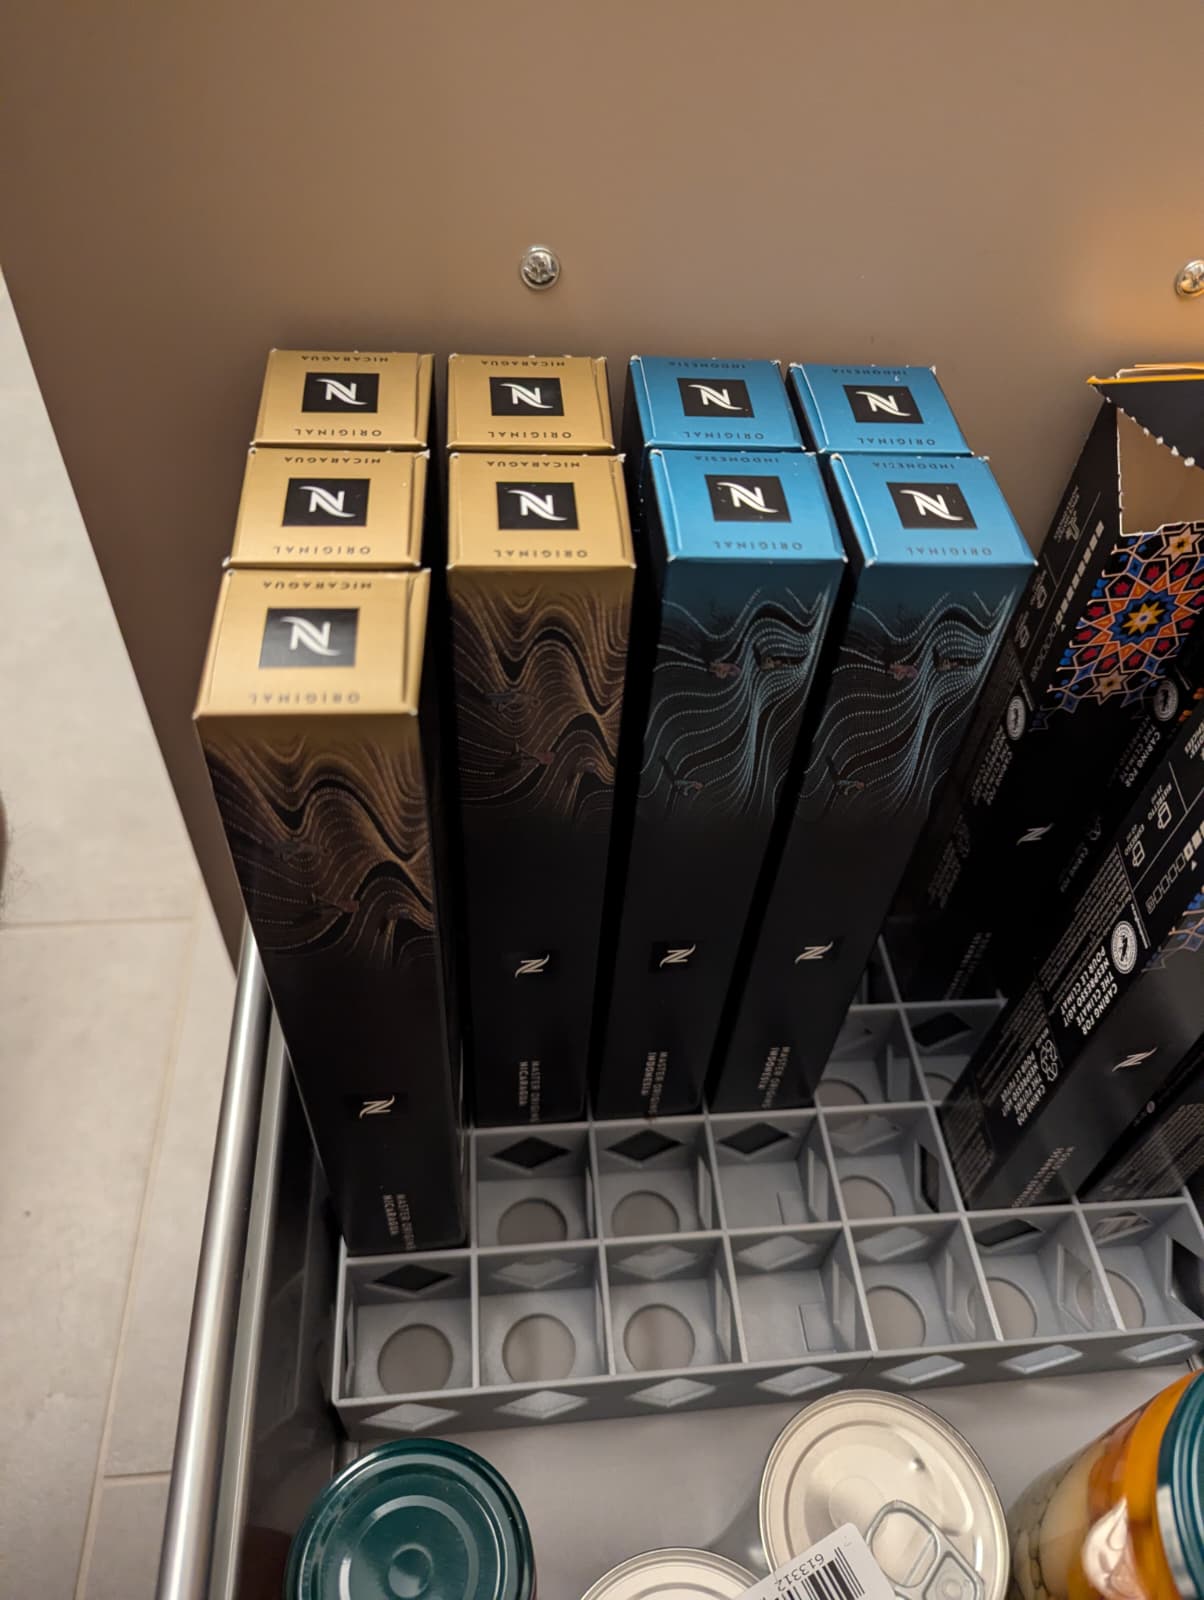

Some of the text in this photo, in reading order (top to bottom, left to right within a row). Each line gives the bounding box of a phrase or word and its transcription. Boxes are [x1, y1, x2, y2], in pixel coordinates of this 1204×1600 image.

[300, 354, 389, 364] NICARAGUA
[480, 359, 566, 368] NICARAGUA
[667, 361, 747, 370] INDONESIA
[830, 367, 909, 377] INDONESIA
[293, 427, 383, 438] ORIGINAL
[487, 430, 572, 440] ORIGINAL
[681, 430, 765, 441] ORIGINAL
[856, 436, 937, 446] ORIGINAL
[282, 454, 382, 465] NICARAGUA
[486, 459, 581, 469] NICARAGUA
[692, 454, 781, 464] INDONESIA
[871, 460, 956, 471] INDONESIA
[273, 545, 372, 556] ORIGINAL
[712, 539, 803, 551] ORIGINAL
[905, 545, 993, 557] ORIGINAL
[493, 548, 589, 559] ORIGINAL
[262, 579, 373, 591] NICARAGUA
[248, 690, 360, 704] ORIGINAL
[1124, 730, 1160, 787] CARING FOR
[1059, 946, 1106, 1015] POUR LE CLIMAT
[1061, 957, 1110, 1028] NESPRESSO AGIT
[1075, 971, 1114, 1027] THE CLIMATE
[1081, 982, 1118, 1035] CARING FOR
[655, 1051, 668, 1082] MASTER
[775, 1046, 791, 1076] MASTER
[641, 1051, 657, 1096] INDONESIA
[758, 1047, 779, 1090] INDONESIA
[530, 1060, 541, 1090] MASTER
[518, 1061, 529, 1106] NICARAGUA
[396, 1194, 411, 1221] MASTER
[383, 1194, 400, 1237] NICARAGUA
[774, 1553, 825, 1592] 613312
